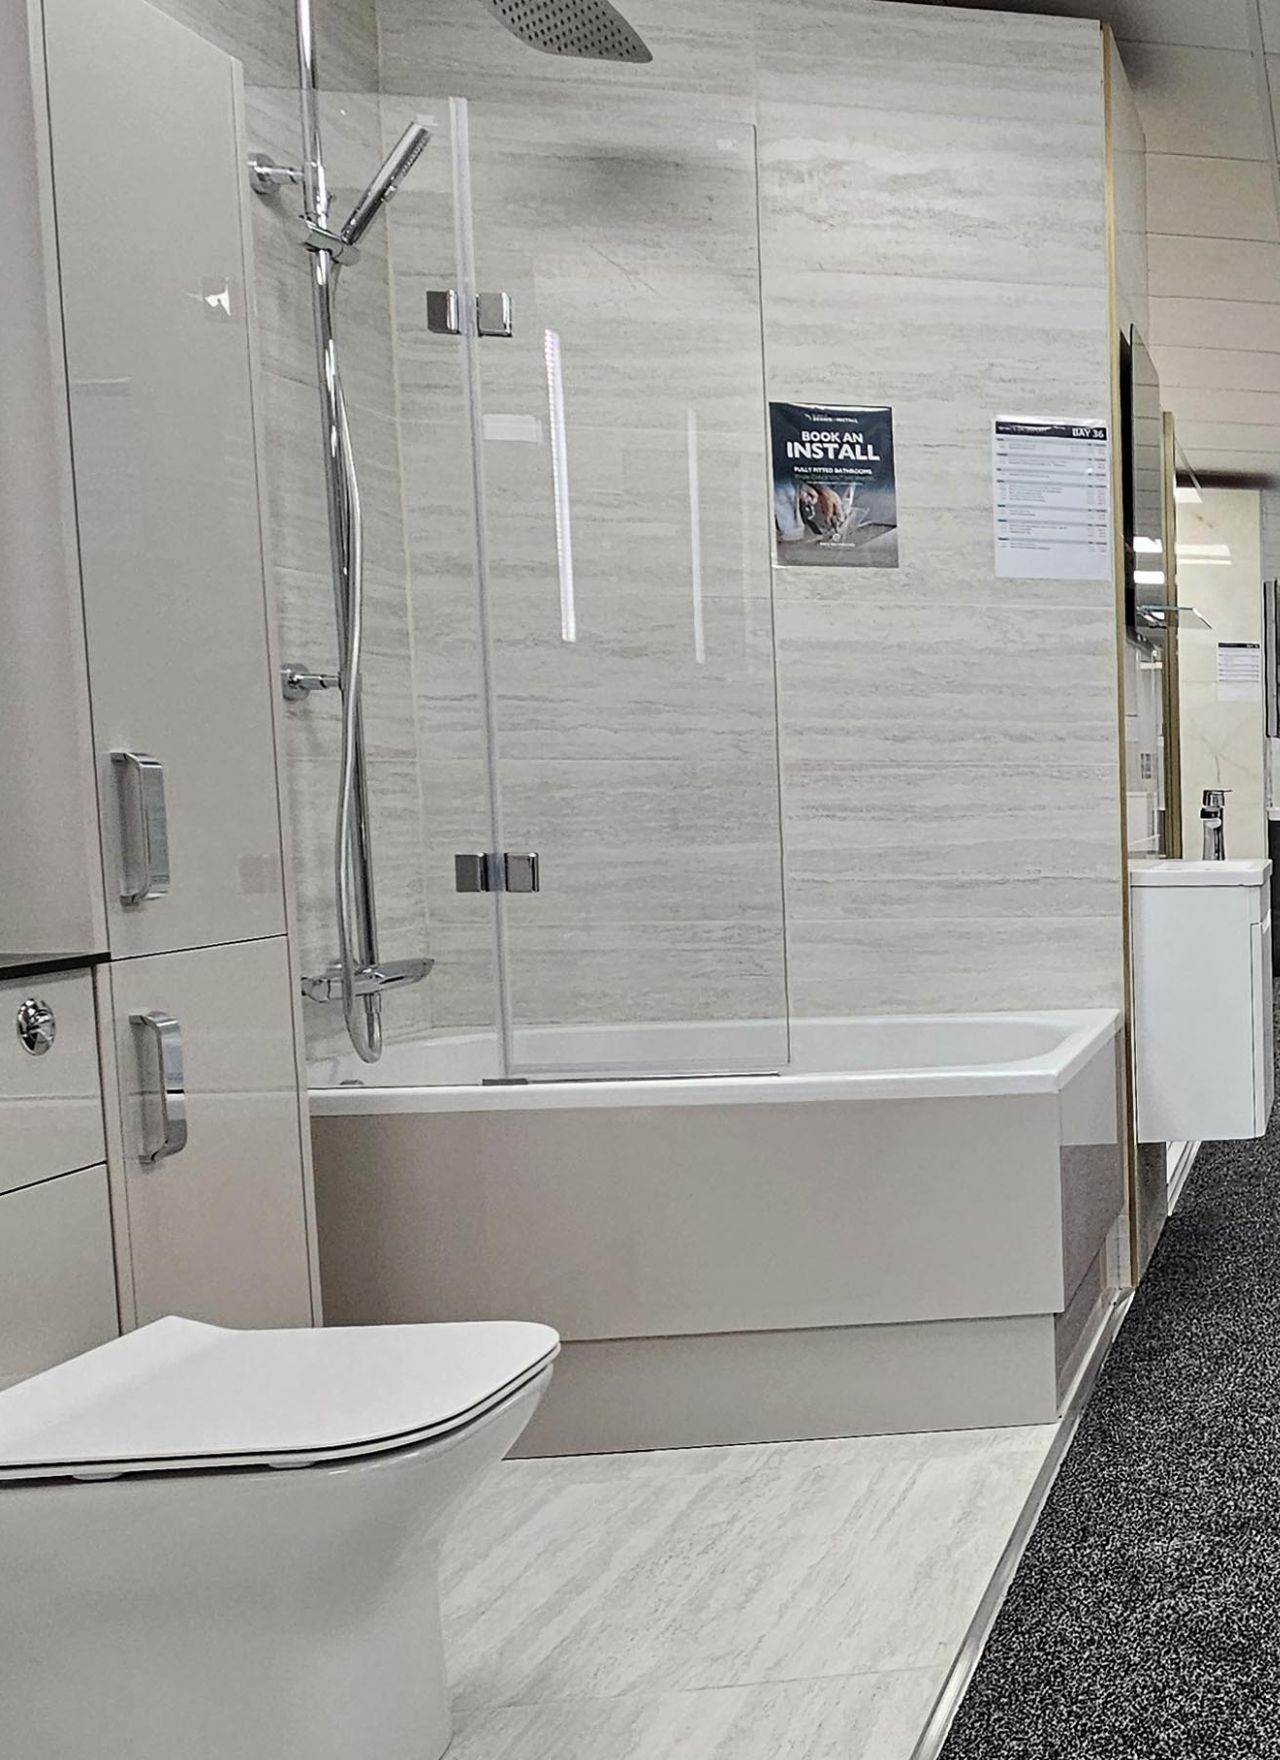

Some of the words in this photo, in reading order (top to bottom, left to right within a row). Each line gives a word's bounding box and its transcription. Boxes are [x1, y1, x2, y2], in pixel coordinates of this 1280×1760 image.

[801, 430, 841, 443] BOOK
[842, 432, 864, 444] AN
[1072, 427, 1091, 438] BAY
[1092, 430, 1104, 438] 36
[786, 441, 881, 461] INSTALL
[834, 467, 873, 475] BATHROOMS
